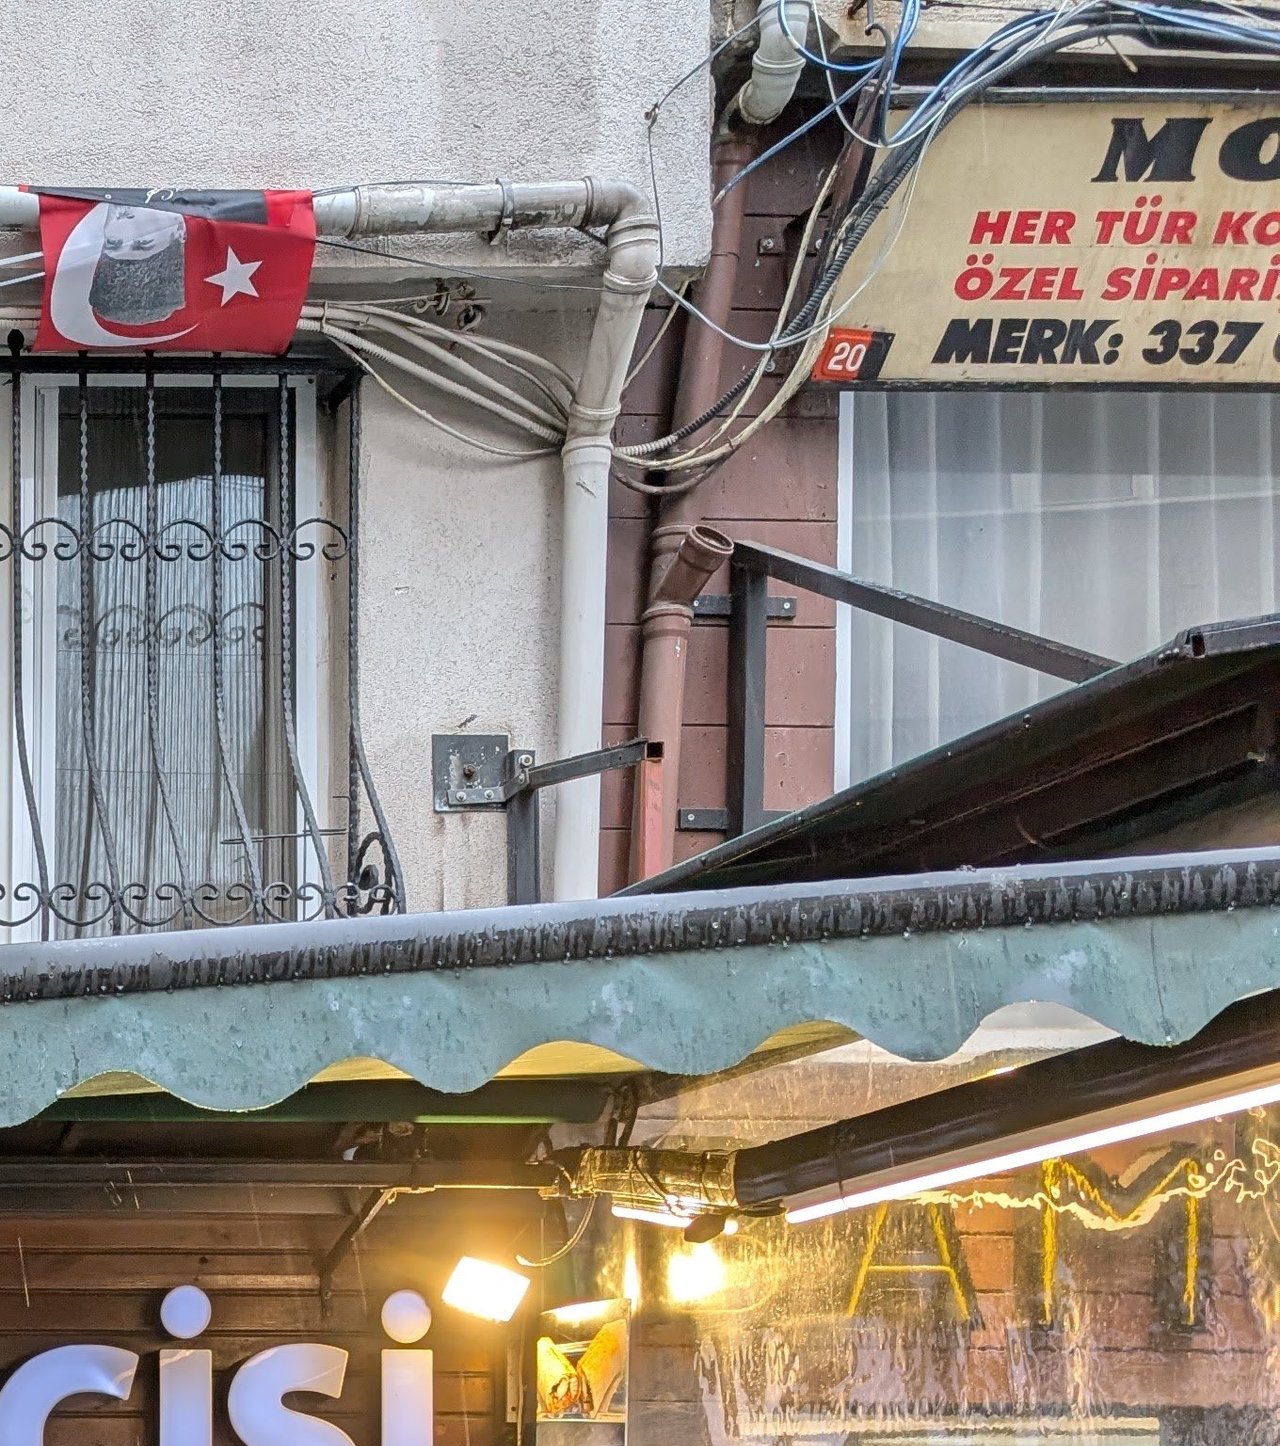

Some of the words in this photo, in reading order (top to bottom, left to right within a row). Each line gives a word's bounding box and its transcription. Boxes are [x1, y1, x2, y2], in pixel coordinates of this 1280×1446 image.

[969, 210, 1076, 246] HER
[1095, 195, 1198, 246] TÜR
[953, 252, 1084, 301] ÖZEL
[1100, 252, 1280, 312] SİPARİ
[827, 341, 868, 373] 20
[931, 318, 1124, 365] MERK:
[1141, 318, 1264, 365] 337
